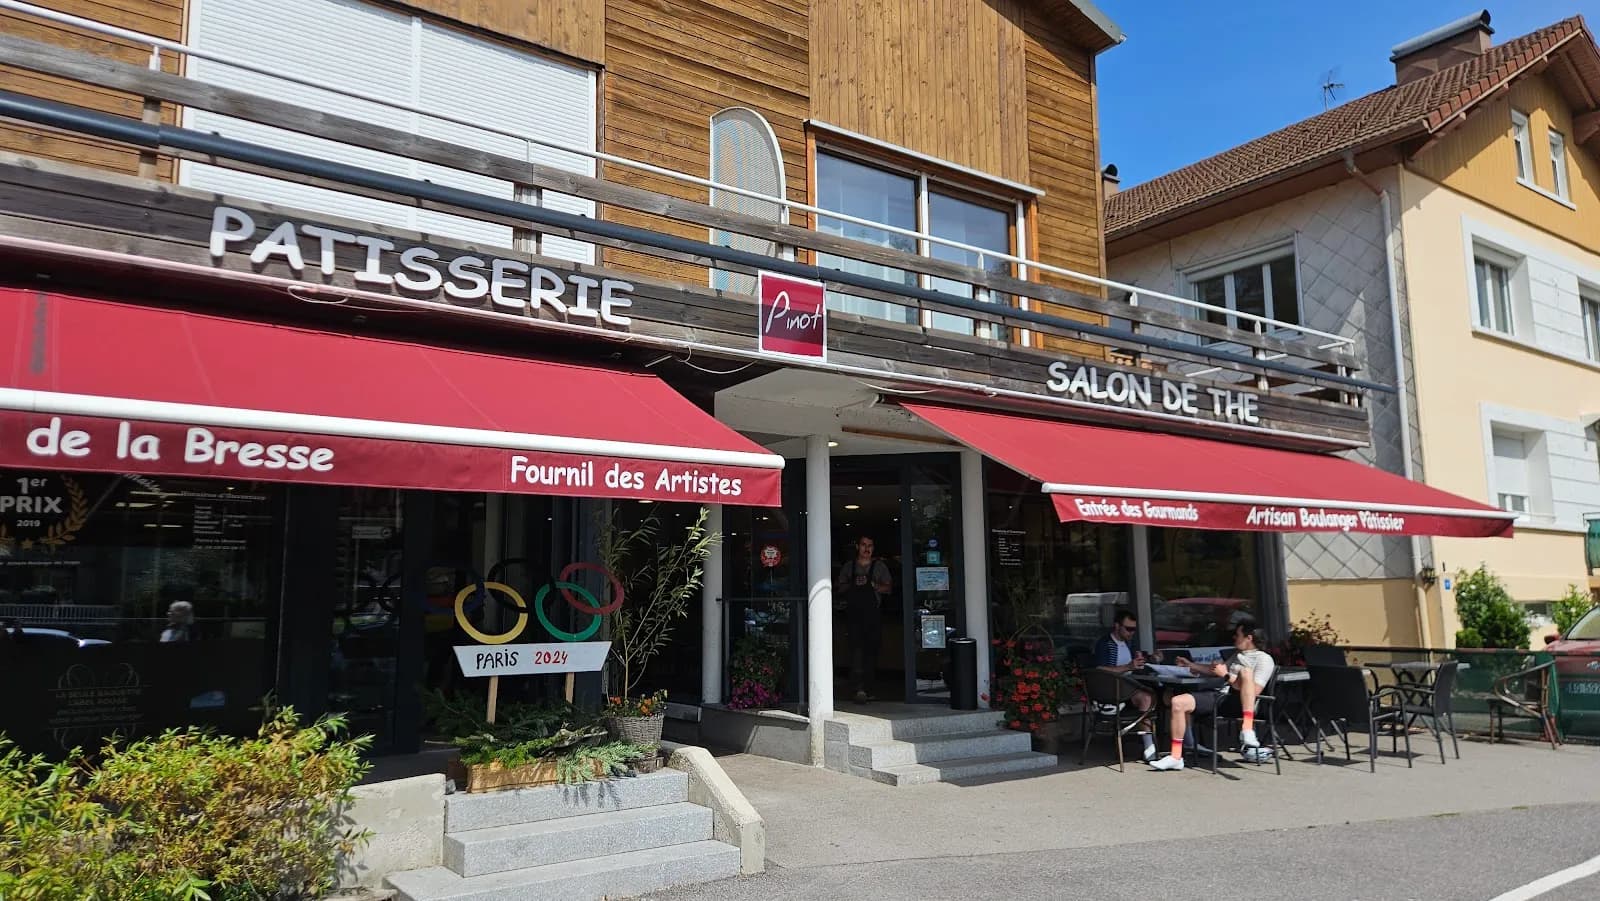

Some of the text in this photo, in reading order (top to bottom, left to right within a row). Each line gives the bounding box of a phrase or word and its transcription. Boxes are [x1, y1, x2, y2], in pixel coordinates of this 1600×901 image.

[209, 206, 635, 326] PATISSERIE
[765, 290, 823, 334] Pinot
[1046, 362, 1260, 425] SALON DE THE
[26, 415, 335, 472] de la Bresse
[16, 477, 47, 494] 1er
[510, 455, 742, 496] Fournil des Artistes
[0, 495, 62, 513] PRIX
[1074, 498, 1199, 522] Entrée des Gourmands
[16, 519, 41, 527] 2019
[1246, 506, 1405, 532] Artisan Boulanger Pâtissier
[535, 650, 569, 665] 2024
